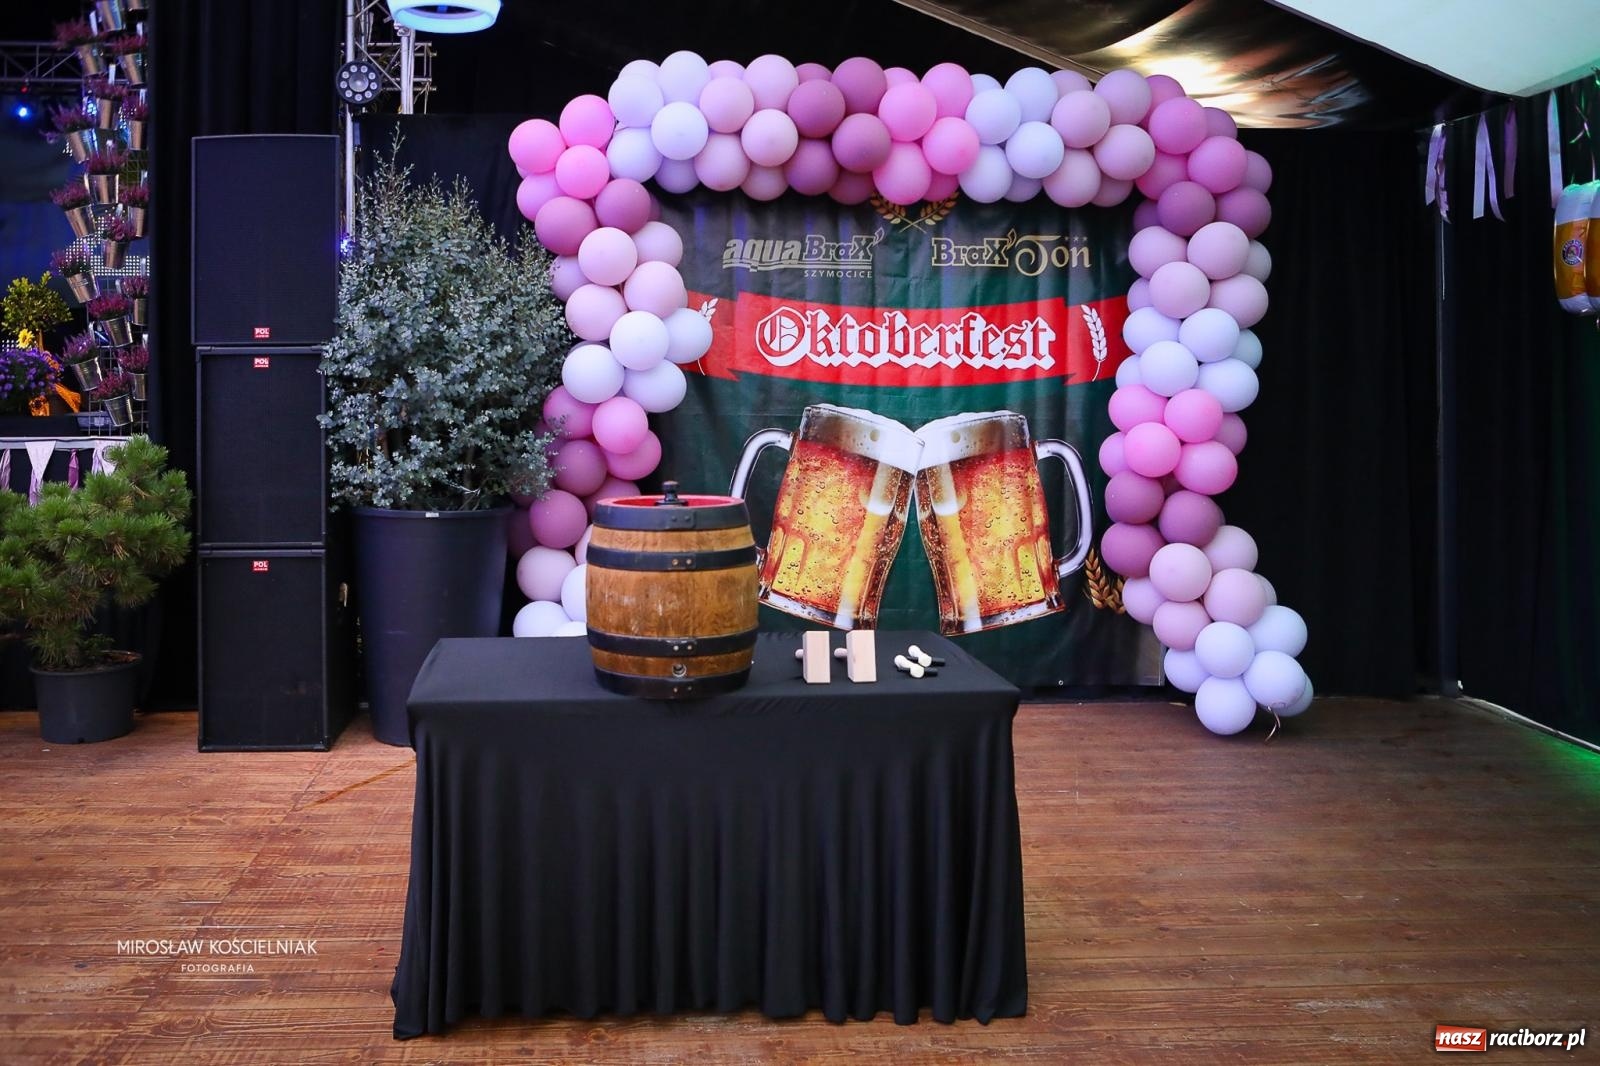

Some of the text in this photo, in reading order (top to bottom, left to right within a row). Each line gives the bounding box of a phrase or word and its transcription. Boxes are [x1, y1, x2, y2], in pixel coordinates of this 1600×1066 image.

[804, 270, 872, 279] SZYMOCICE
[254, 327, 270, 335] POL
[755, 306, 1056, 370] Oktoberfest
[253, 560, 268, 568] POL
